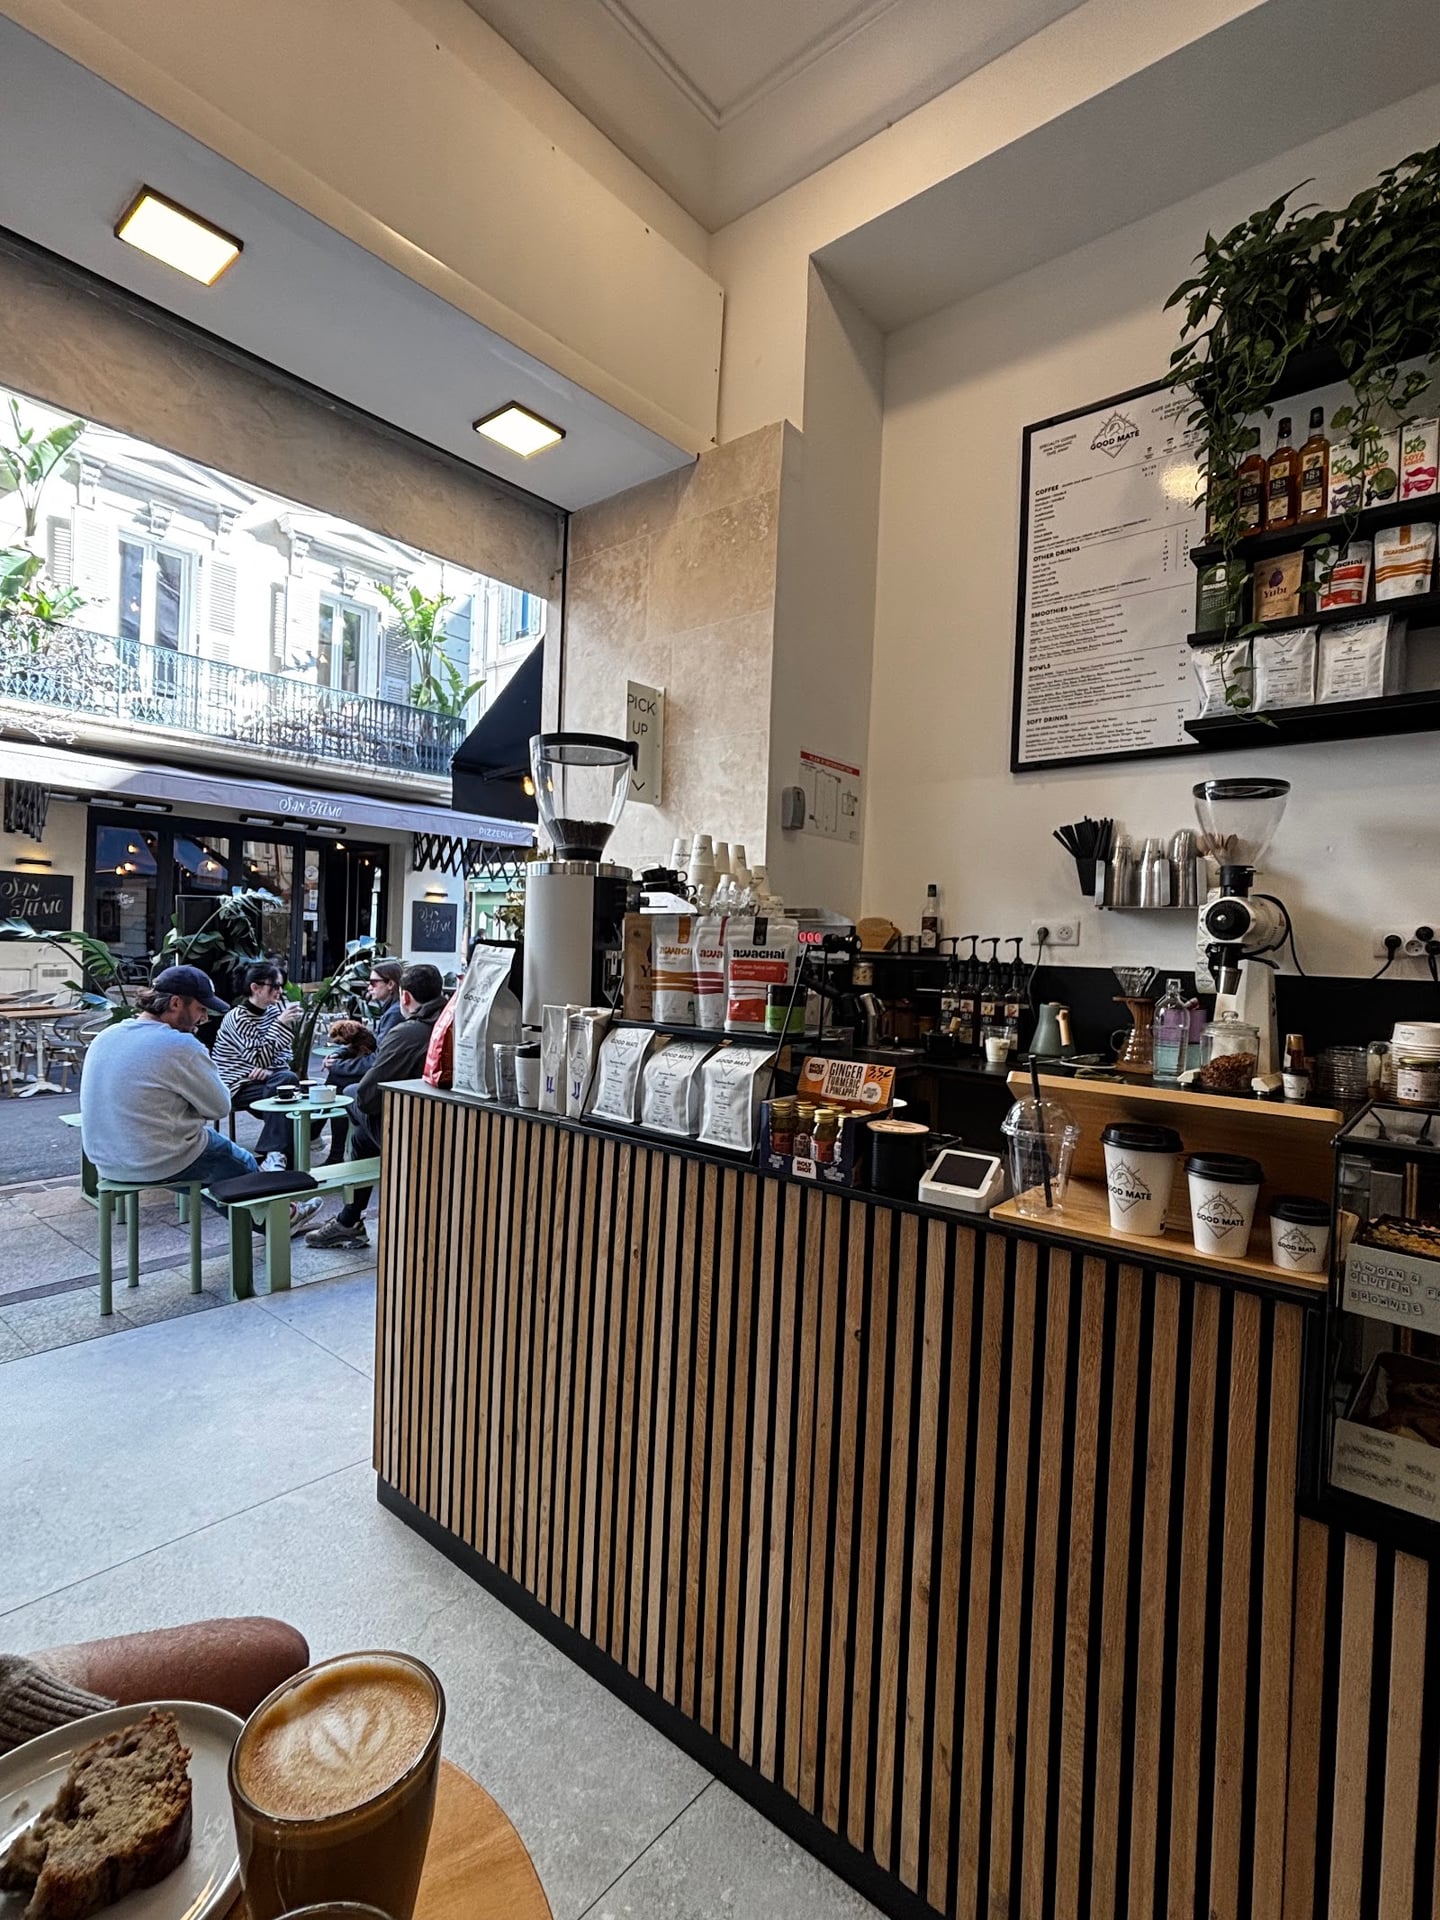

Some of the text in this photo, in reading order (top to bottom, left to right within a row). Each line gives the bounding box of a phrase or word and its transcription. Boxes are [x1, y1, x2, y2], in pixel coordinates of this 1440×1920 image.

[1090, 429, 1140, 451] GOOD MATE
[1035, 484, 1059, 496] COFFEE
[1033, 546, 1080, 562] OTHER DRINKS
[1031, 606, 1068, 619] SMOOTHIES
[1029, 663, 1051, 672] BOWLS
[627, 693, 656, 716] PICK
[1044, 714, 1068, 723] DRINKS
[632, 719, 649, 736] UP
[479, 826, 513, 839] PIZZERIA
[829, 1062, 864, 1079] GINGER
[827, 1075, 862, 1089] TURMERIC
[829, 1085, 859, 1098] PINEAPPLE
[797, 1160, 812, 1168] HOLY
[1126, 1190, 1152, 1200] MATE
[1197, 1212, 1245, 1226] GOOD MATE
[1277, 1241, 1297, 1251] GOOD
[1352, 1262, 1403, 1278] VEGAN
